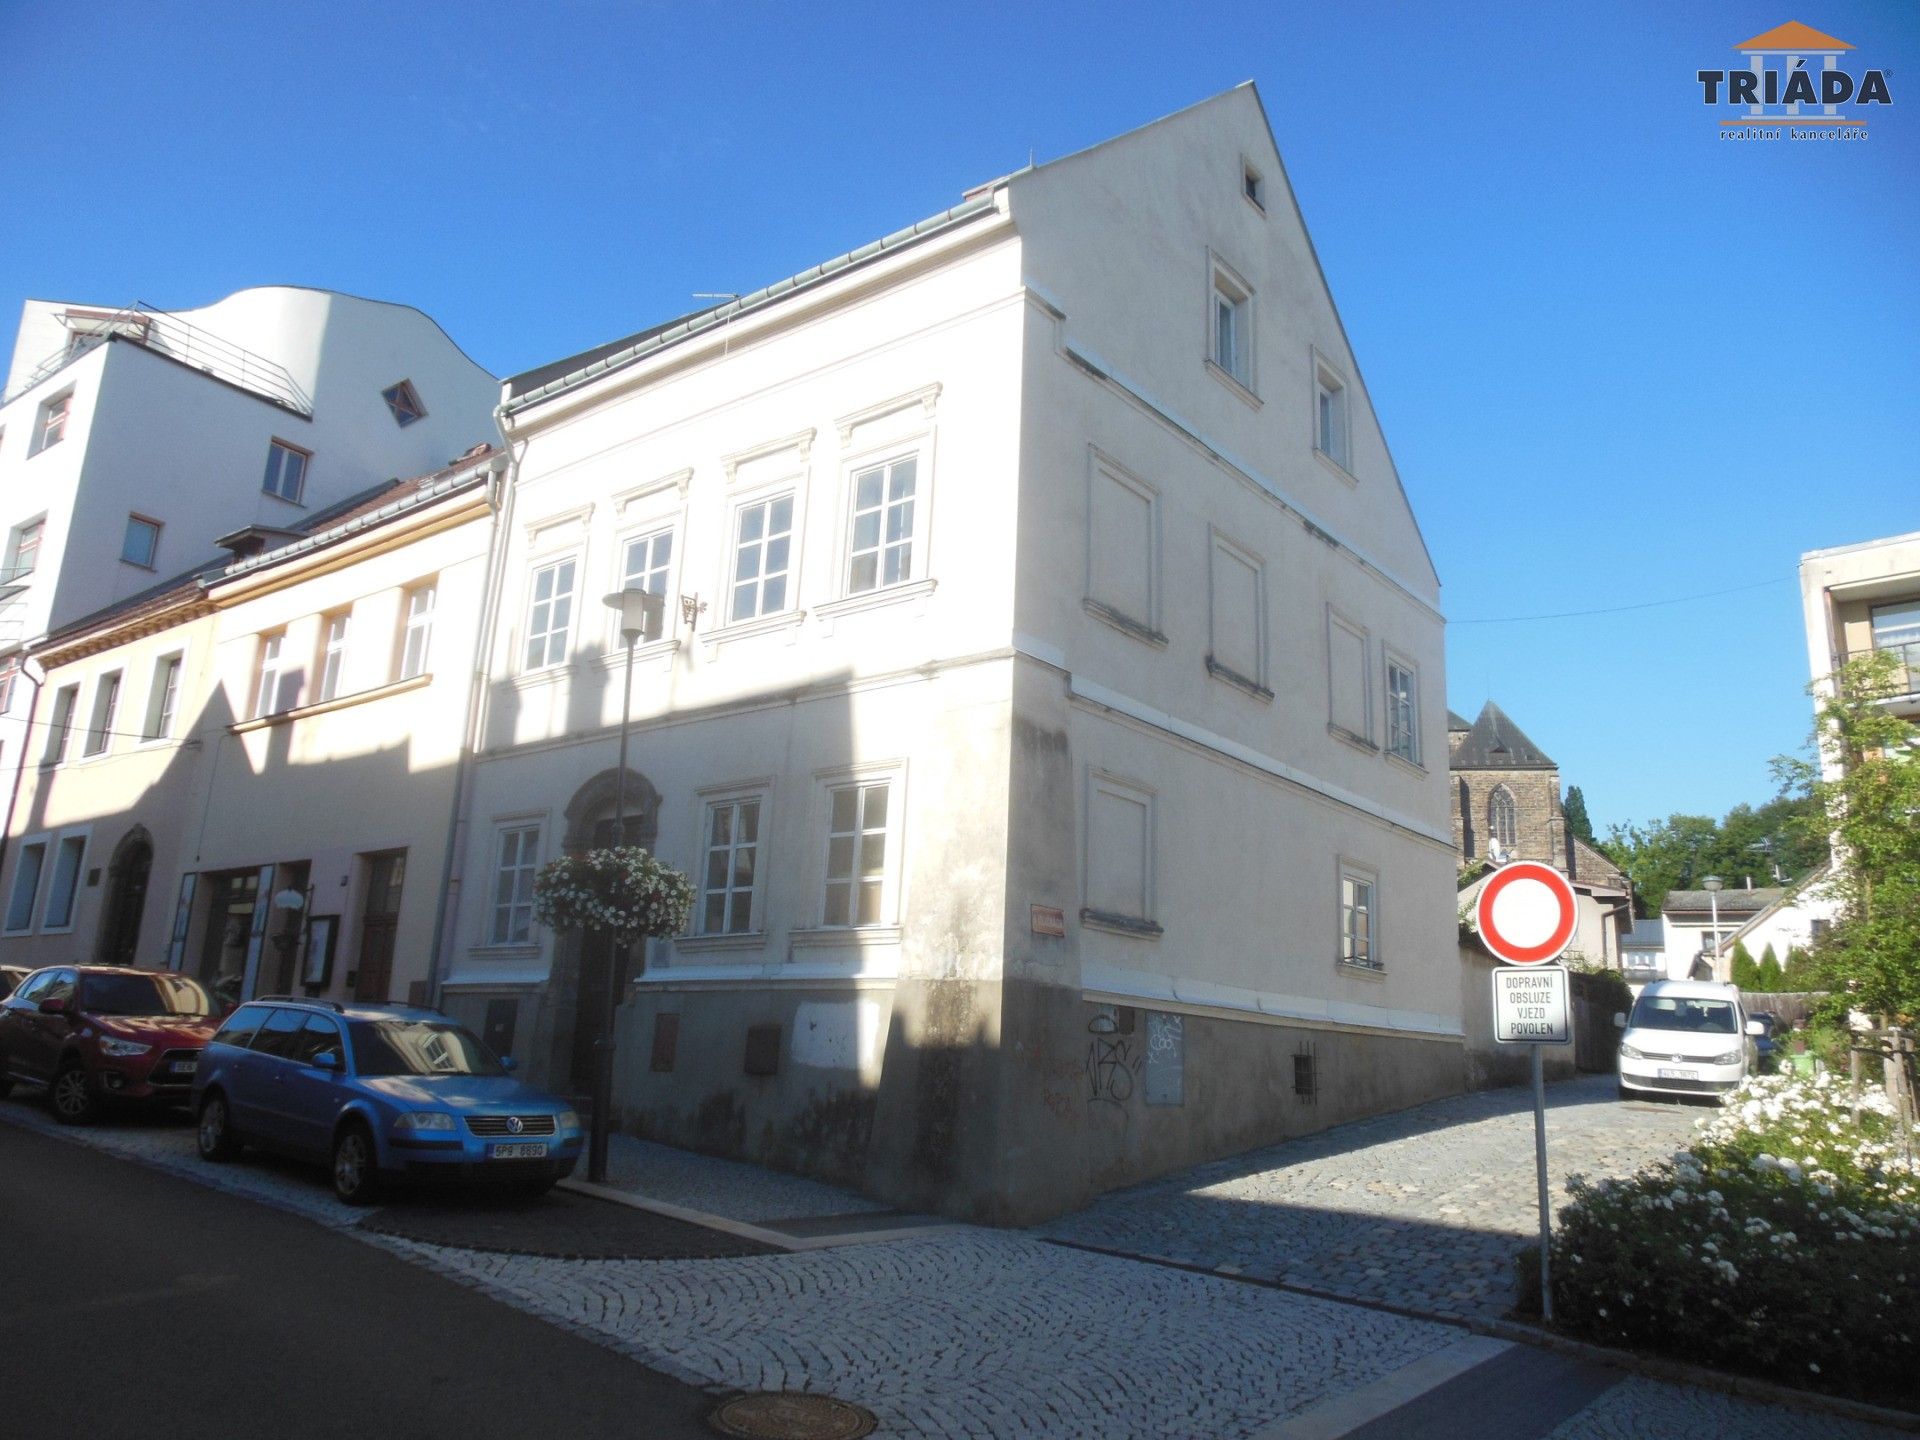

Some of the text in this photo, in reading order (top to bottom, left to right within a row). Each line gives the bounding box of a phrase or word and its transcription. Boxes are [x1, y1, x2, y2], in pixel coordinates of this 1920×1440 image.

[1506, 974, 1553, 989] DOPRAVNÍ
[1509, 992, 1551, 1004] OBSLUZE
[1517, 1007, 1546, 1019] VJEZD
[1510, 1022, 1553, 1035] POVOLEN
